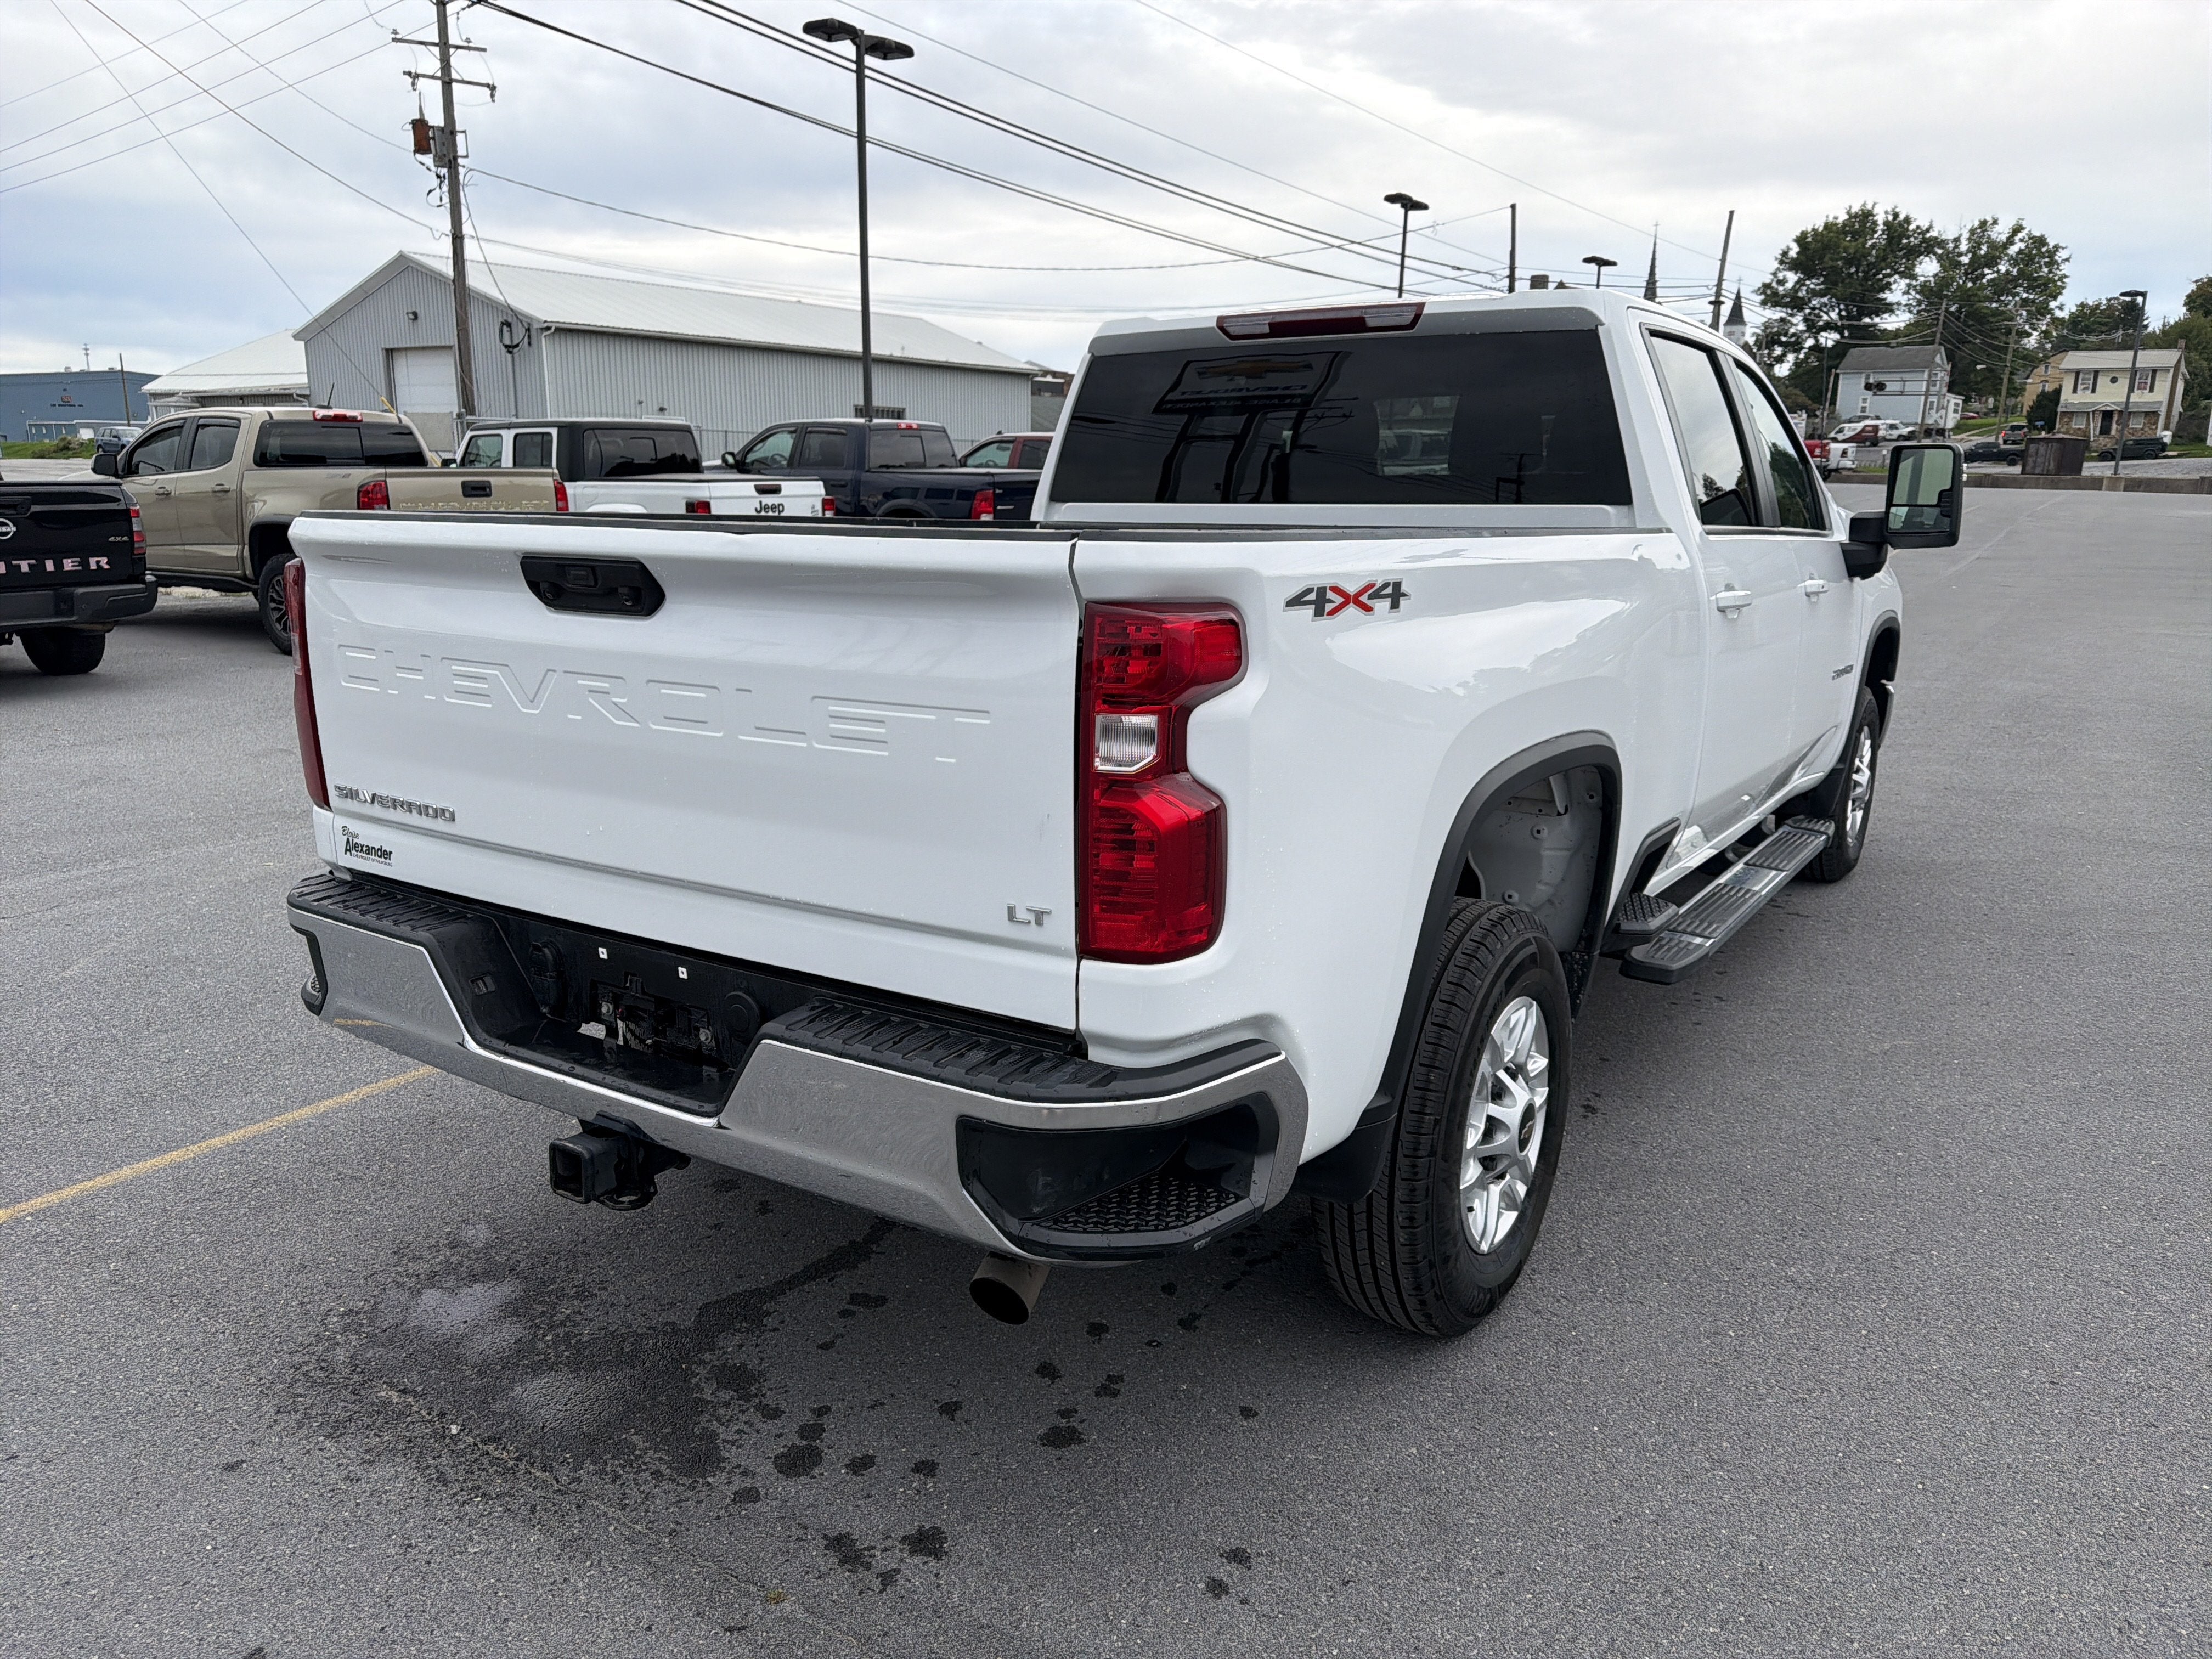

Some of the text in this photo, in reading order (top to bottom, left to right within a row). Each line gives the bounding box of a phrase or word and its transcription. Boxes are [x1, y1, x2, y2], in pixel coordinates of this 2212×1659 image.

[755, 500, 785, 515] Jeep
[0, 557, 110, 574] TIER
[337, 644, 991, 763] CHEVROLET
[334, 783, 456, 822] SILVERADO
[341, 826, 359, 839] Blaise
[344, 837, 393, 861] Alexander
[353, 853, 371, 862] CHEVROLET
[1006, 903, 1052, 926] LT
